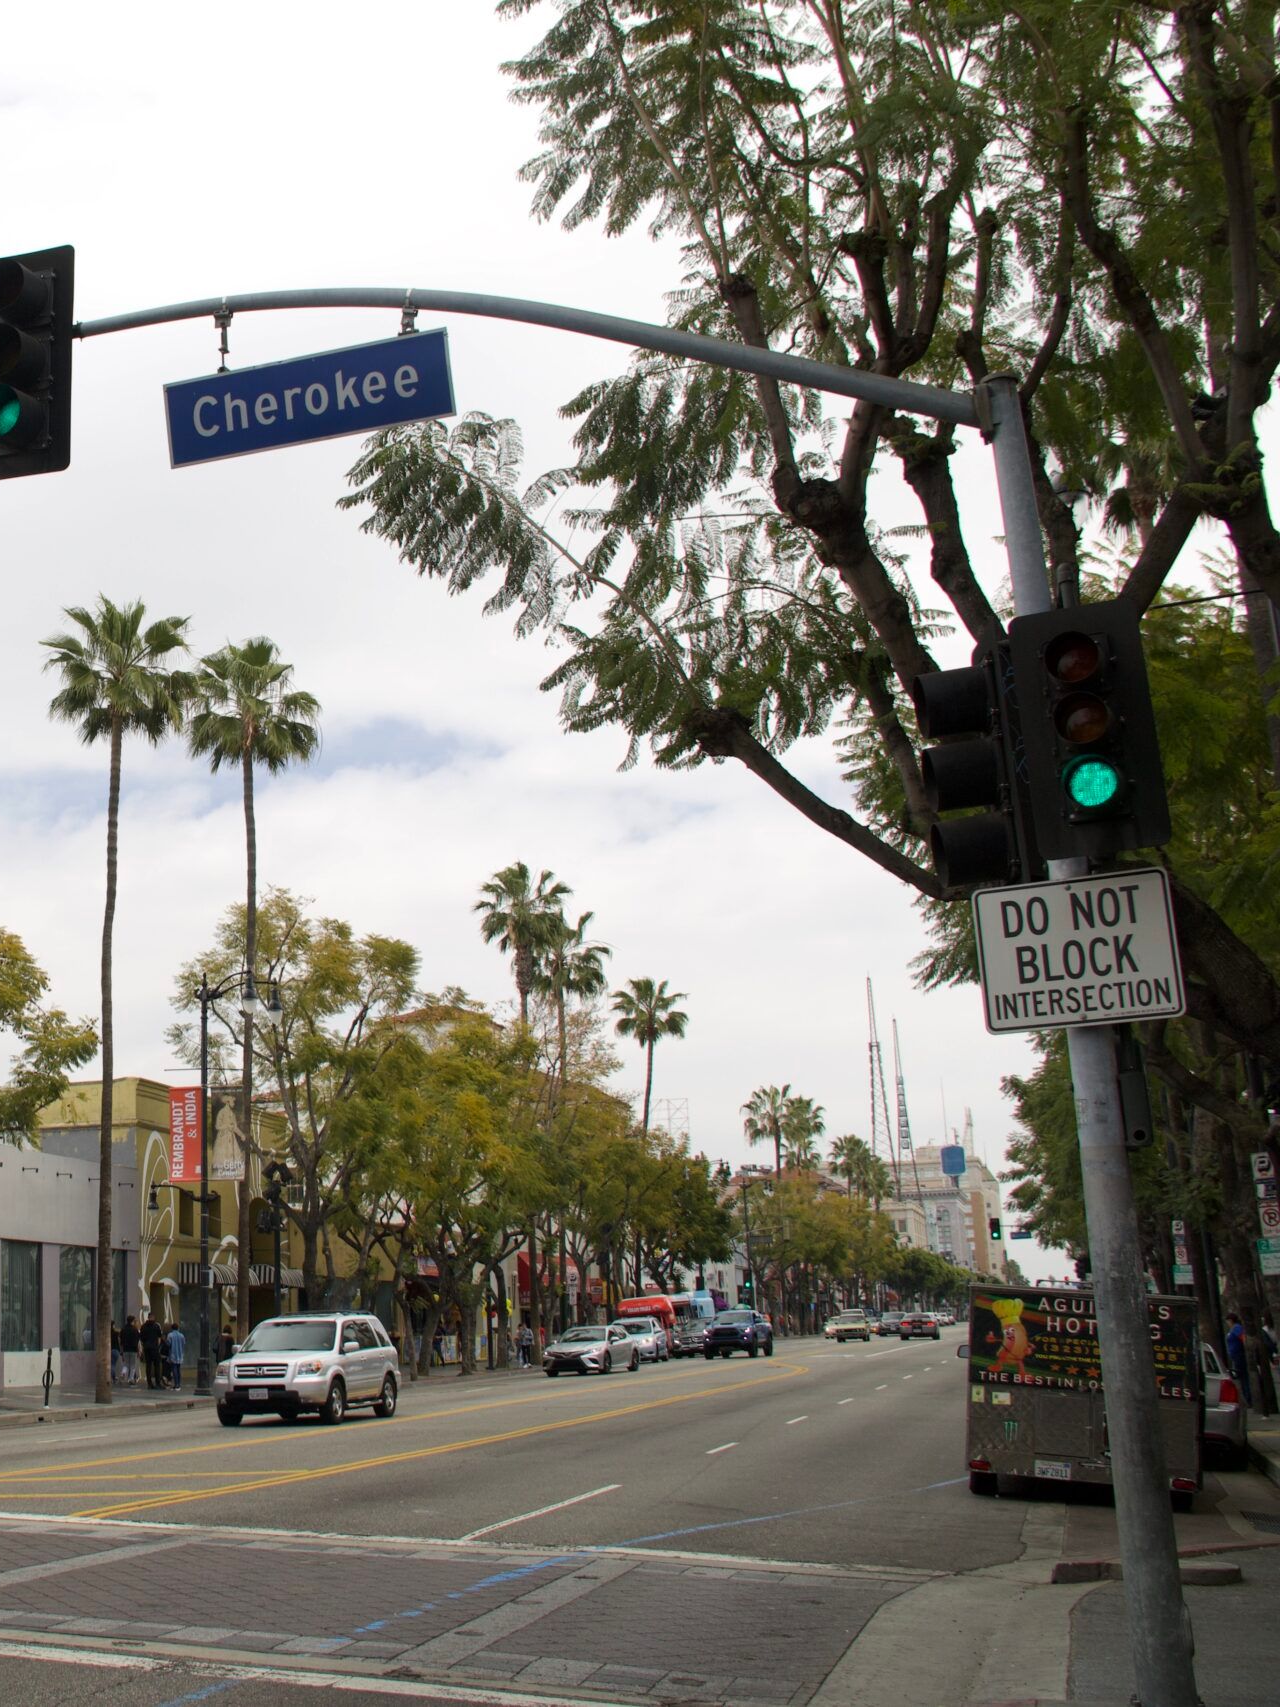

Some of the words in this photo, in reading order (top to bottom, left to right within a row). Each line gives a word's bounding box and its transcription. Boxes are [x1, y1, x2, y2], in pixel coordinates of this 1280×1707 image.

[193, 364, 419, 437] Cherokee
[1000, 896, 1049, 938] DO
[1069, 885, 1140, 931] NOT
[1015, 934, 1140, 984] BLOCK
[994, 977, 1172, 1021] INTERSECTION
[184, 1090, 197, 1125] INDIA
[171, 1100, 184, 1178] REMBRANDT
[188, 1128, 197, 1138] &
[1046, 1316, 1099, 1336] HOT
[979, 1371, 1009, 1382] THE
[1013, 1374, 1054, 1386] BEST
[1058, 1377, 1074, 1388] IN
